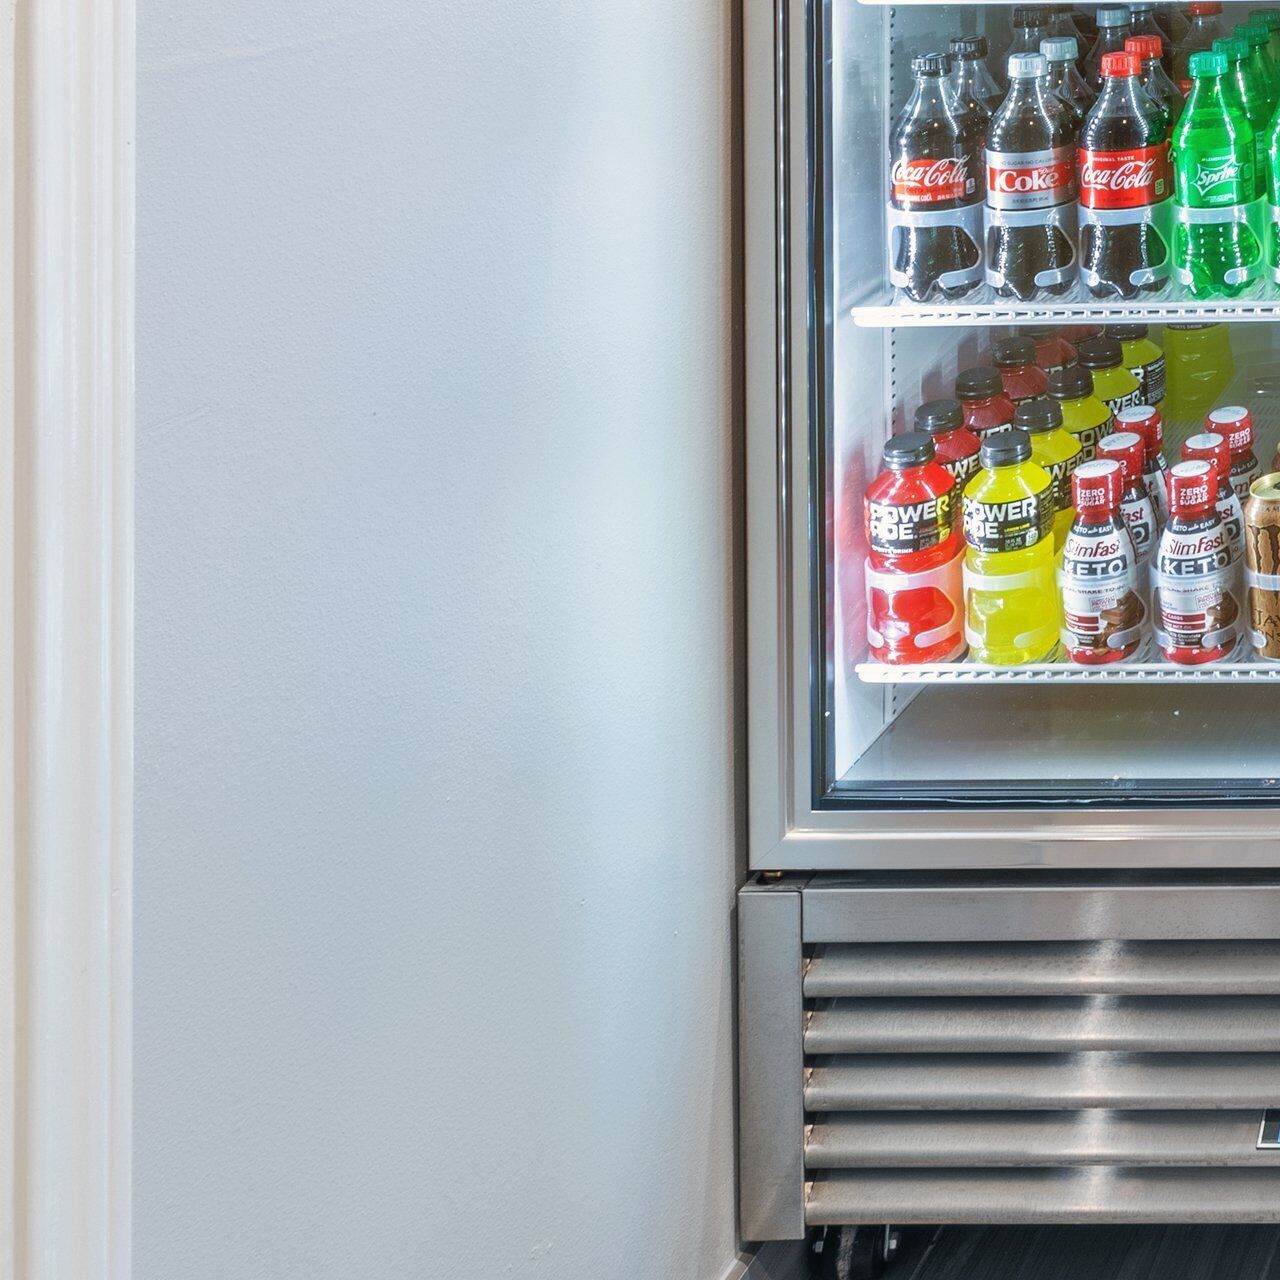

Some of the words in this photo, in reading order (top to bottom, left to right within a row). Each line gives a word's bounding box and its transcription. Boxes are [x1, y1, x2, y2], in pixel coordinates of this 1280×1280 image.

[999, 169, 1060, 192] Coke
[1081, 158, 1157, 191] Coca-Cola
[1197, 166, 1238, 186] Sprite
[1229, 427, 1251, 441] ZERO
[1080, 488, 1105, 497] ZERO
[1180, 486, 1208, 497] ZERO
[869, 494, 950, 524] POWER
[963, 495, 1038, 523] POWER
[1179, 498, 1208, 506] SUGAR
[869, 522, 916, 542] ADE
[1098, 525, 1113, 534] EASY
[1200, 519, 1216, 529] EASY
[1165, 533, 1225, 557] SlimFast
[1064, 558, 1123, 576] KETO
[1162, 552, 1228, 576] KETO
